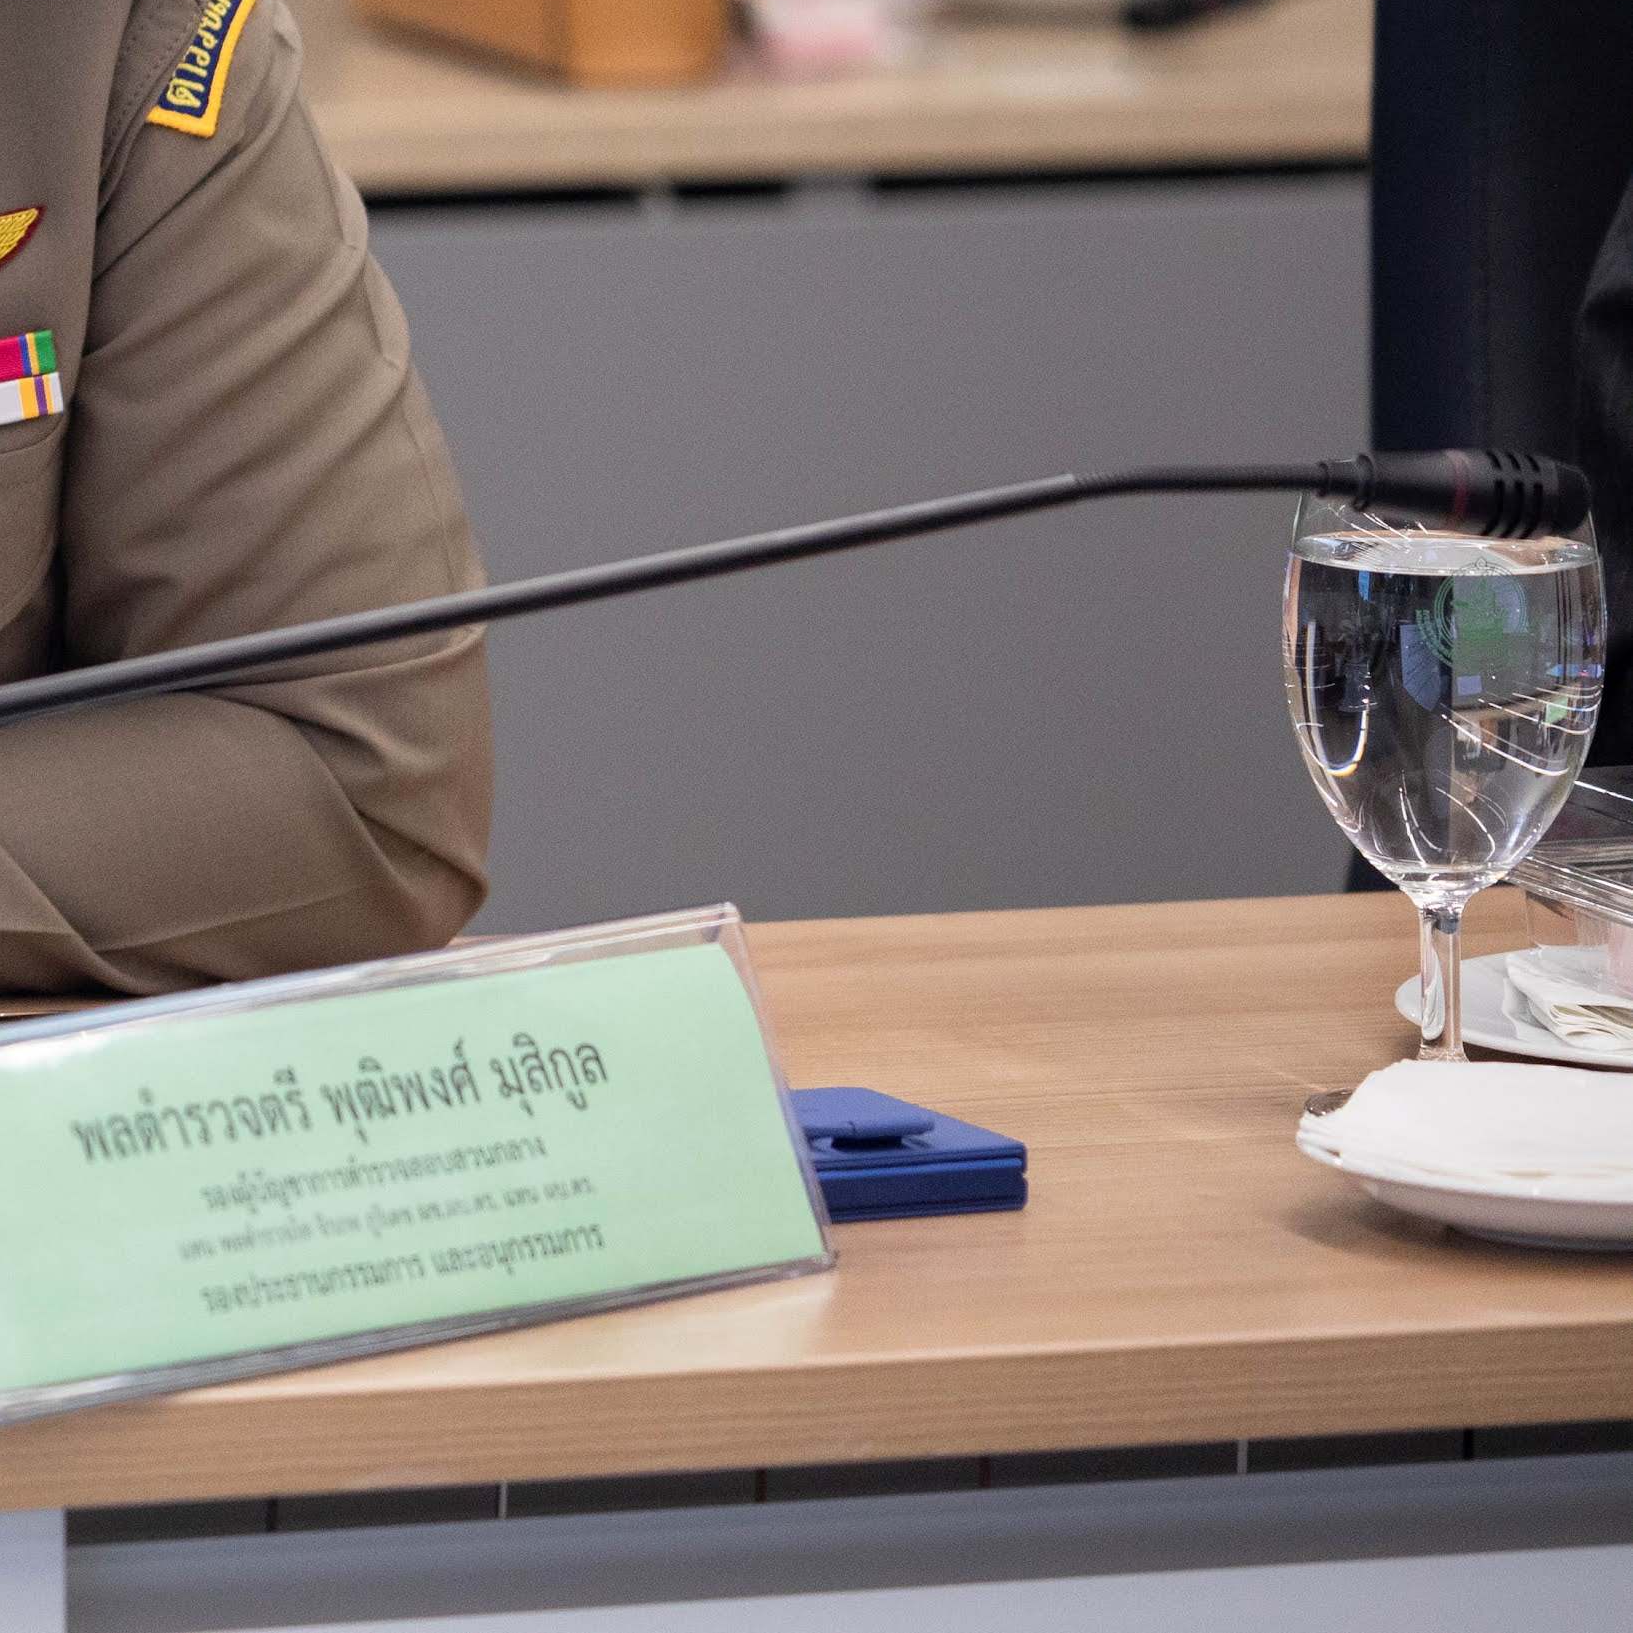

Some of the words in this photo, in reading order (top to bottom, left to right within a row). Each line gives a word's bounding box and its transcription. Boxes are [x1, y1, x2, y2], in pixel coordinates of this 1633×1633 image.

[70, 1065, 313, 1165] พลตำรวจตรี
[319, 1035, 482, 1145] พุฒิพงศ์
[489, 1031, 609, 1117] มุสิกูล
